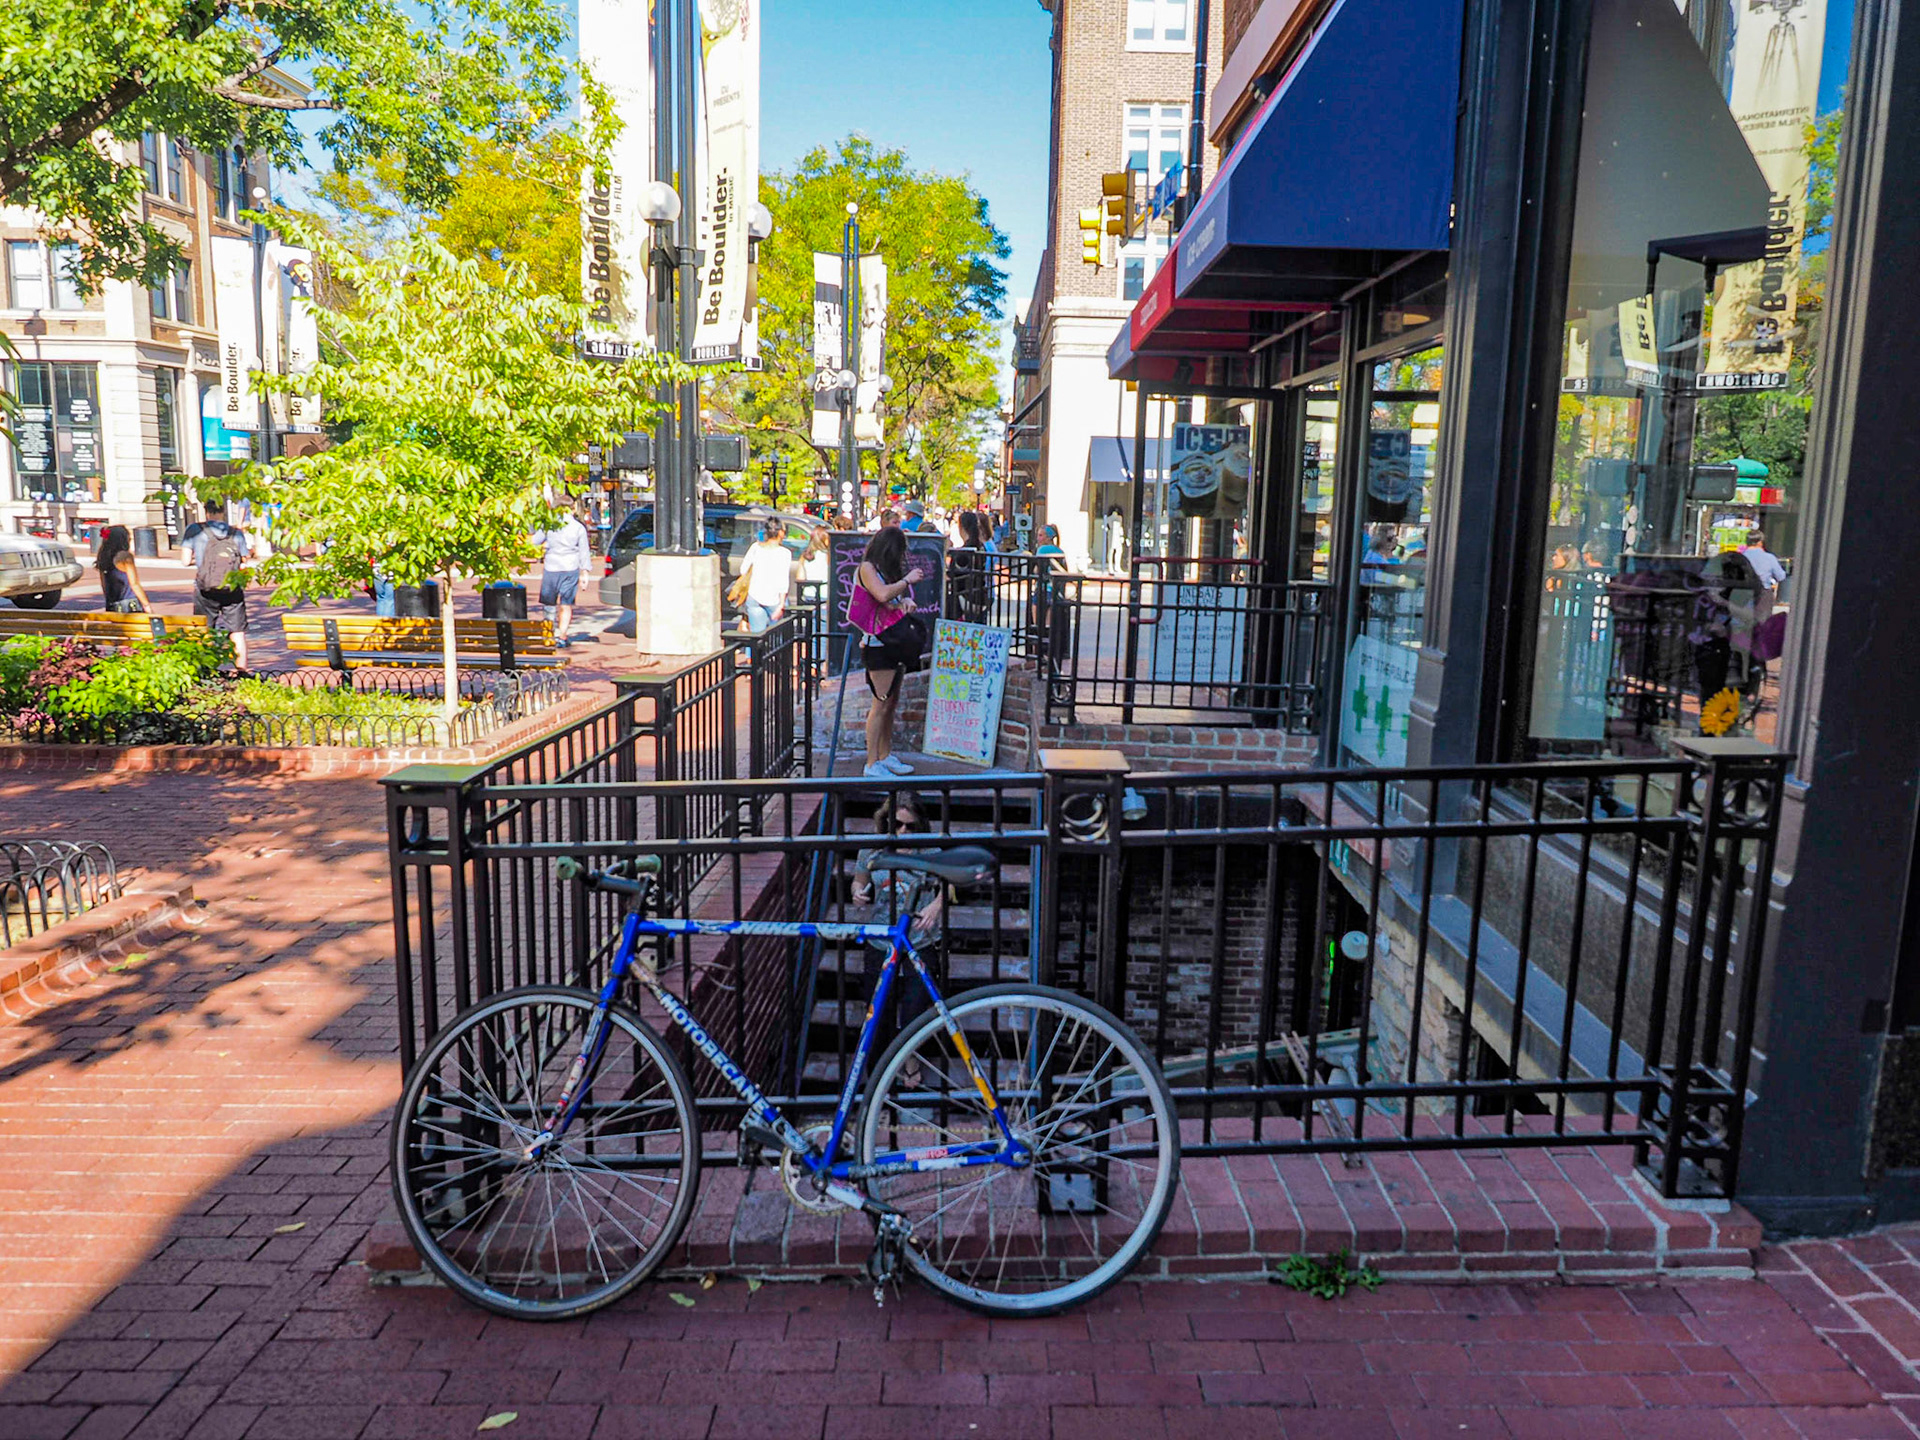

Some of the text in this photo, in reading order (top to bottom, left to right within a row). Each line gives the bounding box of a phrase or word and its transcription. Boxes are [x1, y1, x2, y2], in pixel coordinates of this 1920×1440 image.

[613, 175, 623, 200] FILM
[702, 167, 728, 326] Be Boulder.
[588, 287, 612, 324] Be
[226, 342, 239, 413] Be Boulder.
[695, 344, 731, 360] BOULDER
[932, 699, 979, 716] STUDENTS
[660, 991, 770, 1116] MOTOBECANE
[840, 1049, 866, 1119] MOTOBECANE
